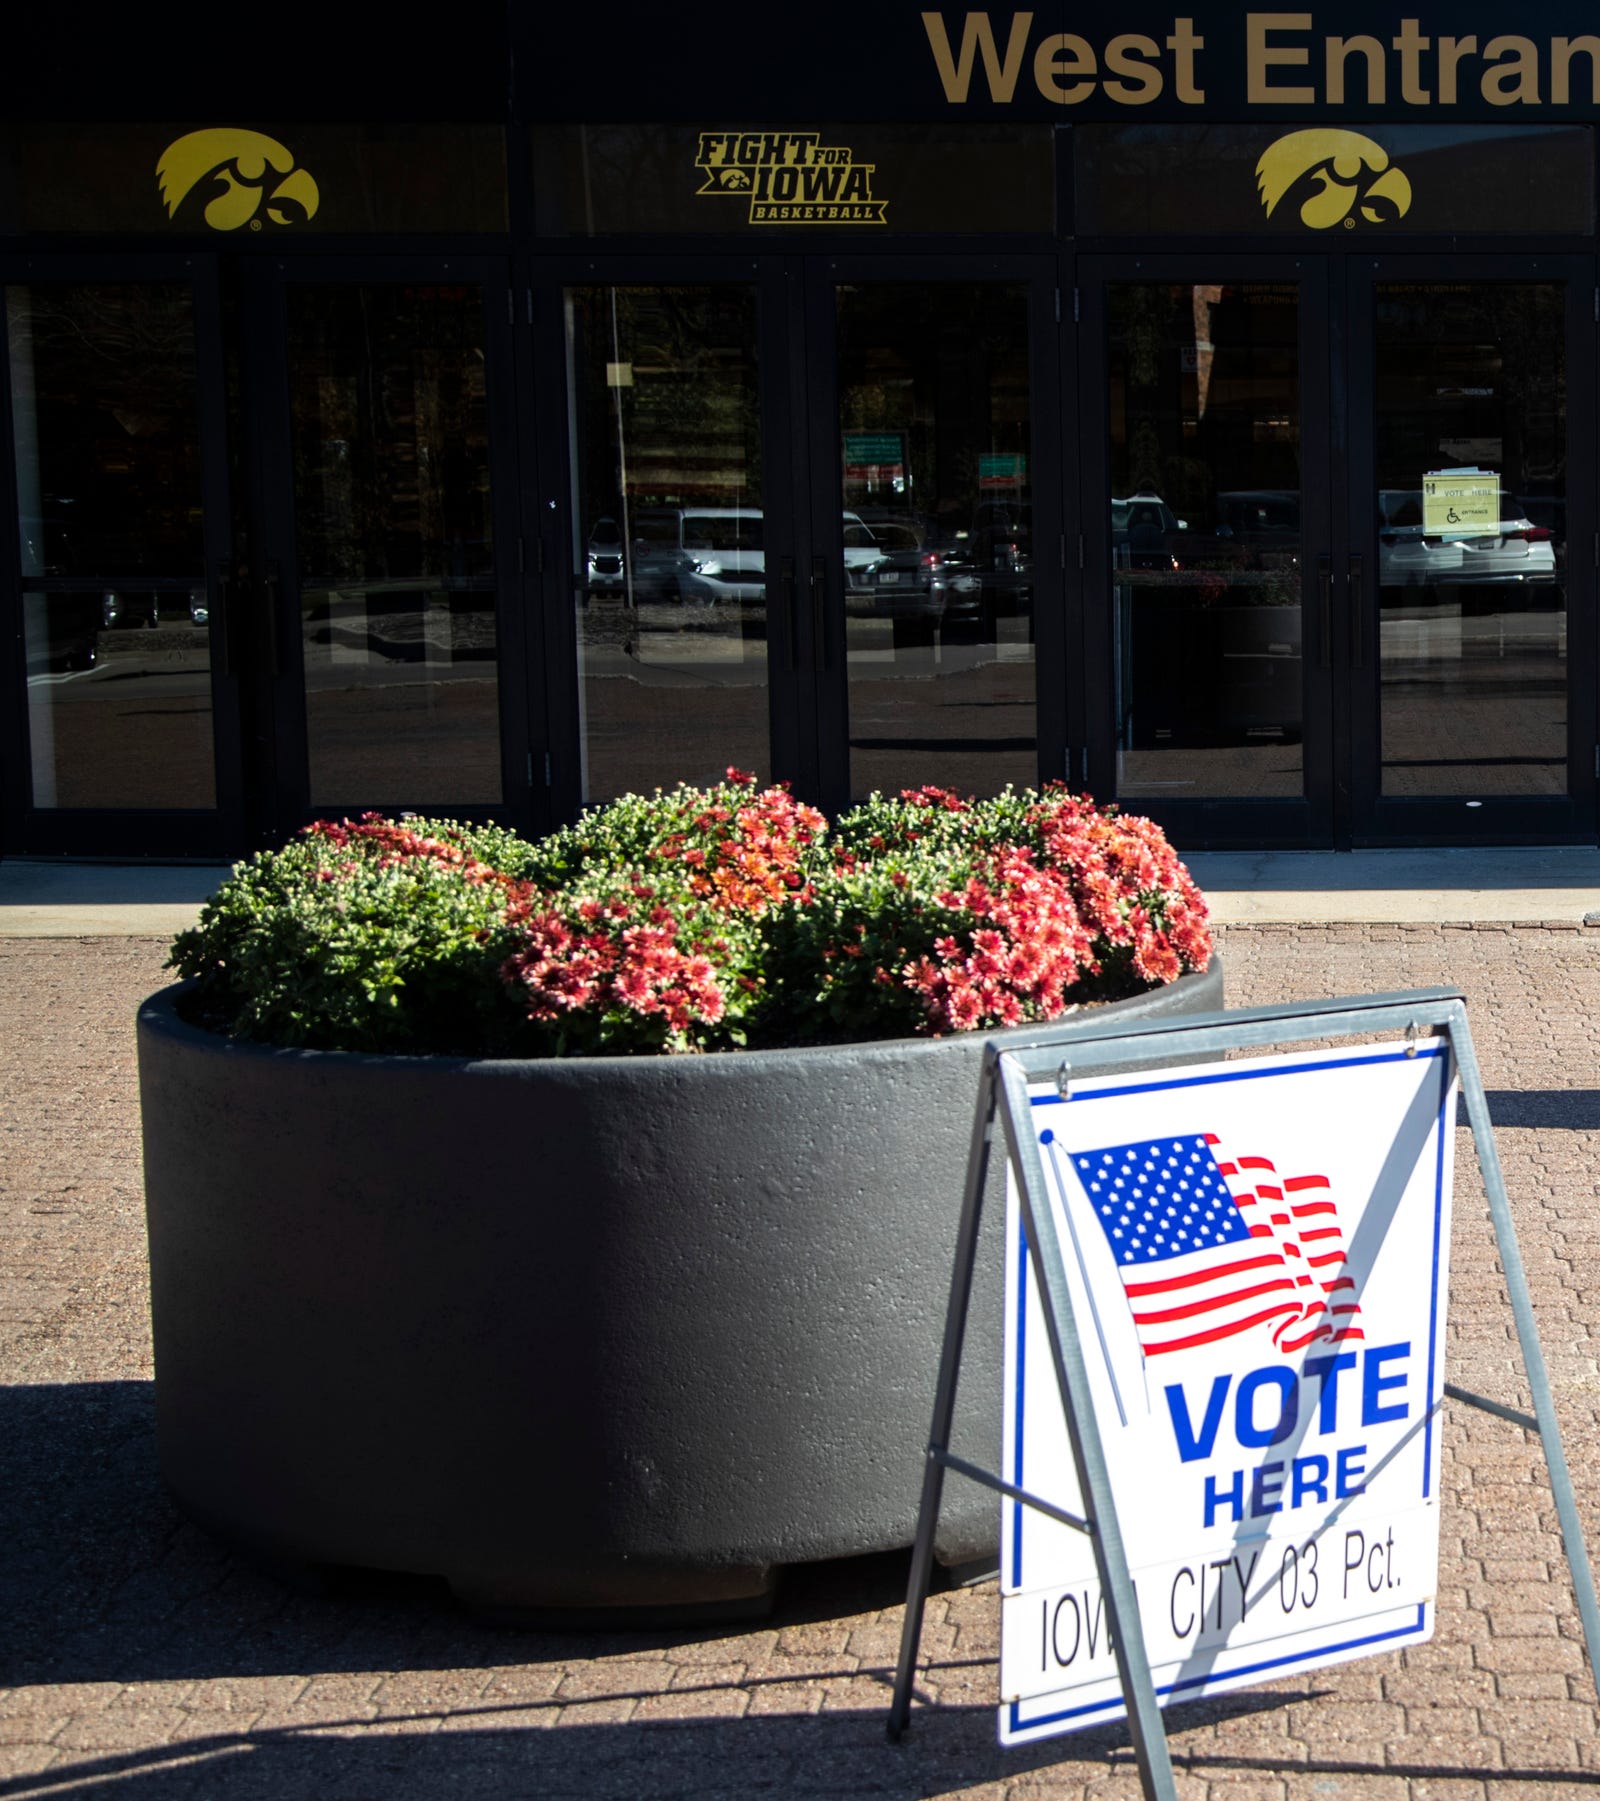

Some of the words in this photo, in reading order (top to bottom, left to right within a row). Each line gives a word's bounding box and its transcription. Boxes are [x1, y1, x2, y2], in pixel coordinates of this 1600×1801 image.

[920, 9, 1204, 106] West
[697, 134, 819, 164] FIGHT
[812, 150, 850, 164] FOR
[755, 166, 870, 200] IOWA
[755, 206, 873, 219] BASKETBALL
[1444, 489, 1464, 497] VOTE
[1164, 1342, 1412, 1463] VOTE
[1203, 1444, 1368, 1529] HERE
[1042, 1579, 1138, 1672] IOW
[1171, 1550, 1260, 1640] CITY
[1280, 1539, 1319, 1613] 03
[1344, 1526, 1401, 1601] Pct.
